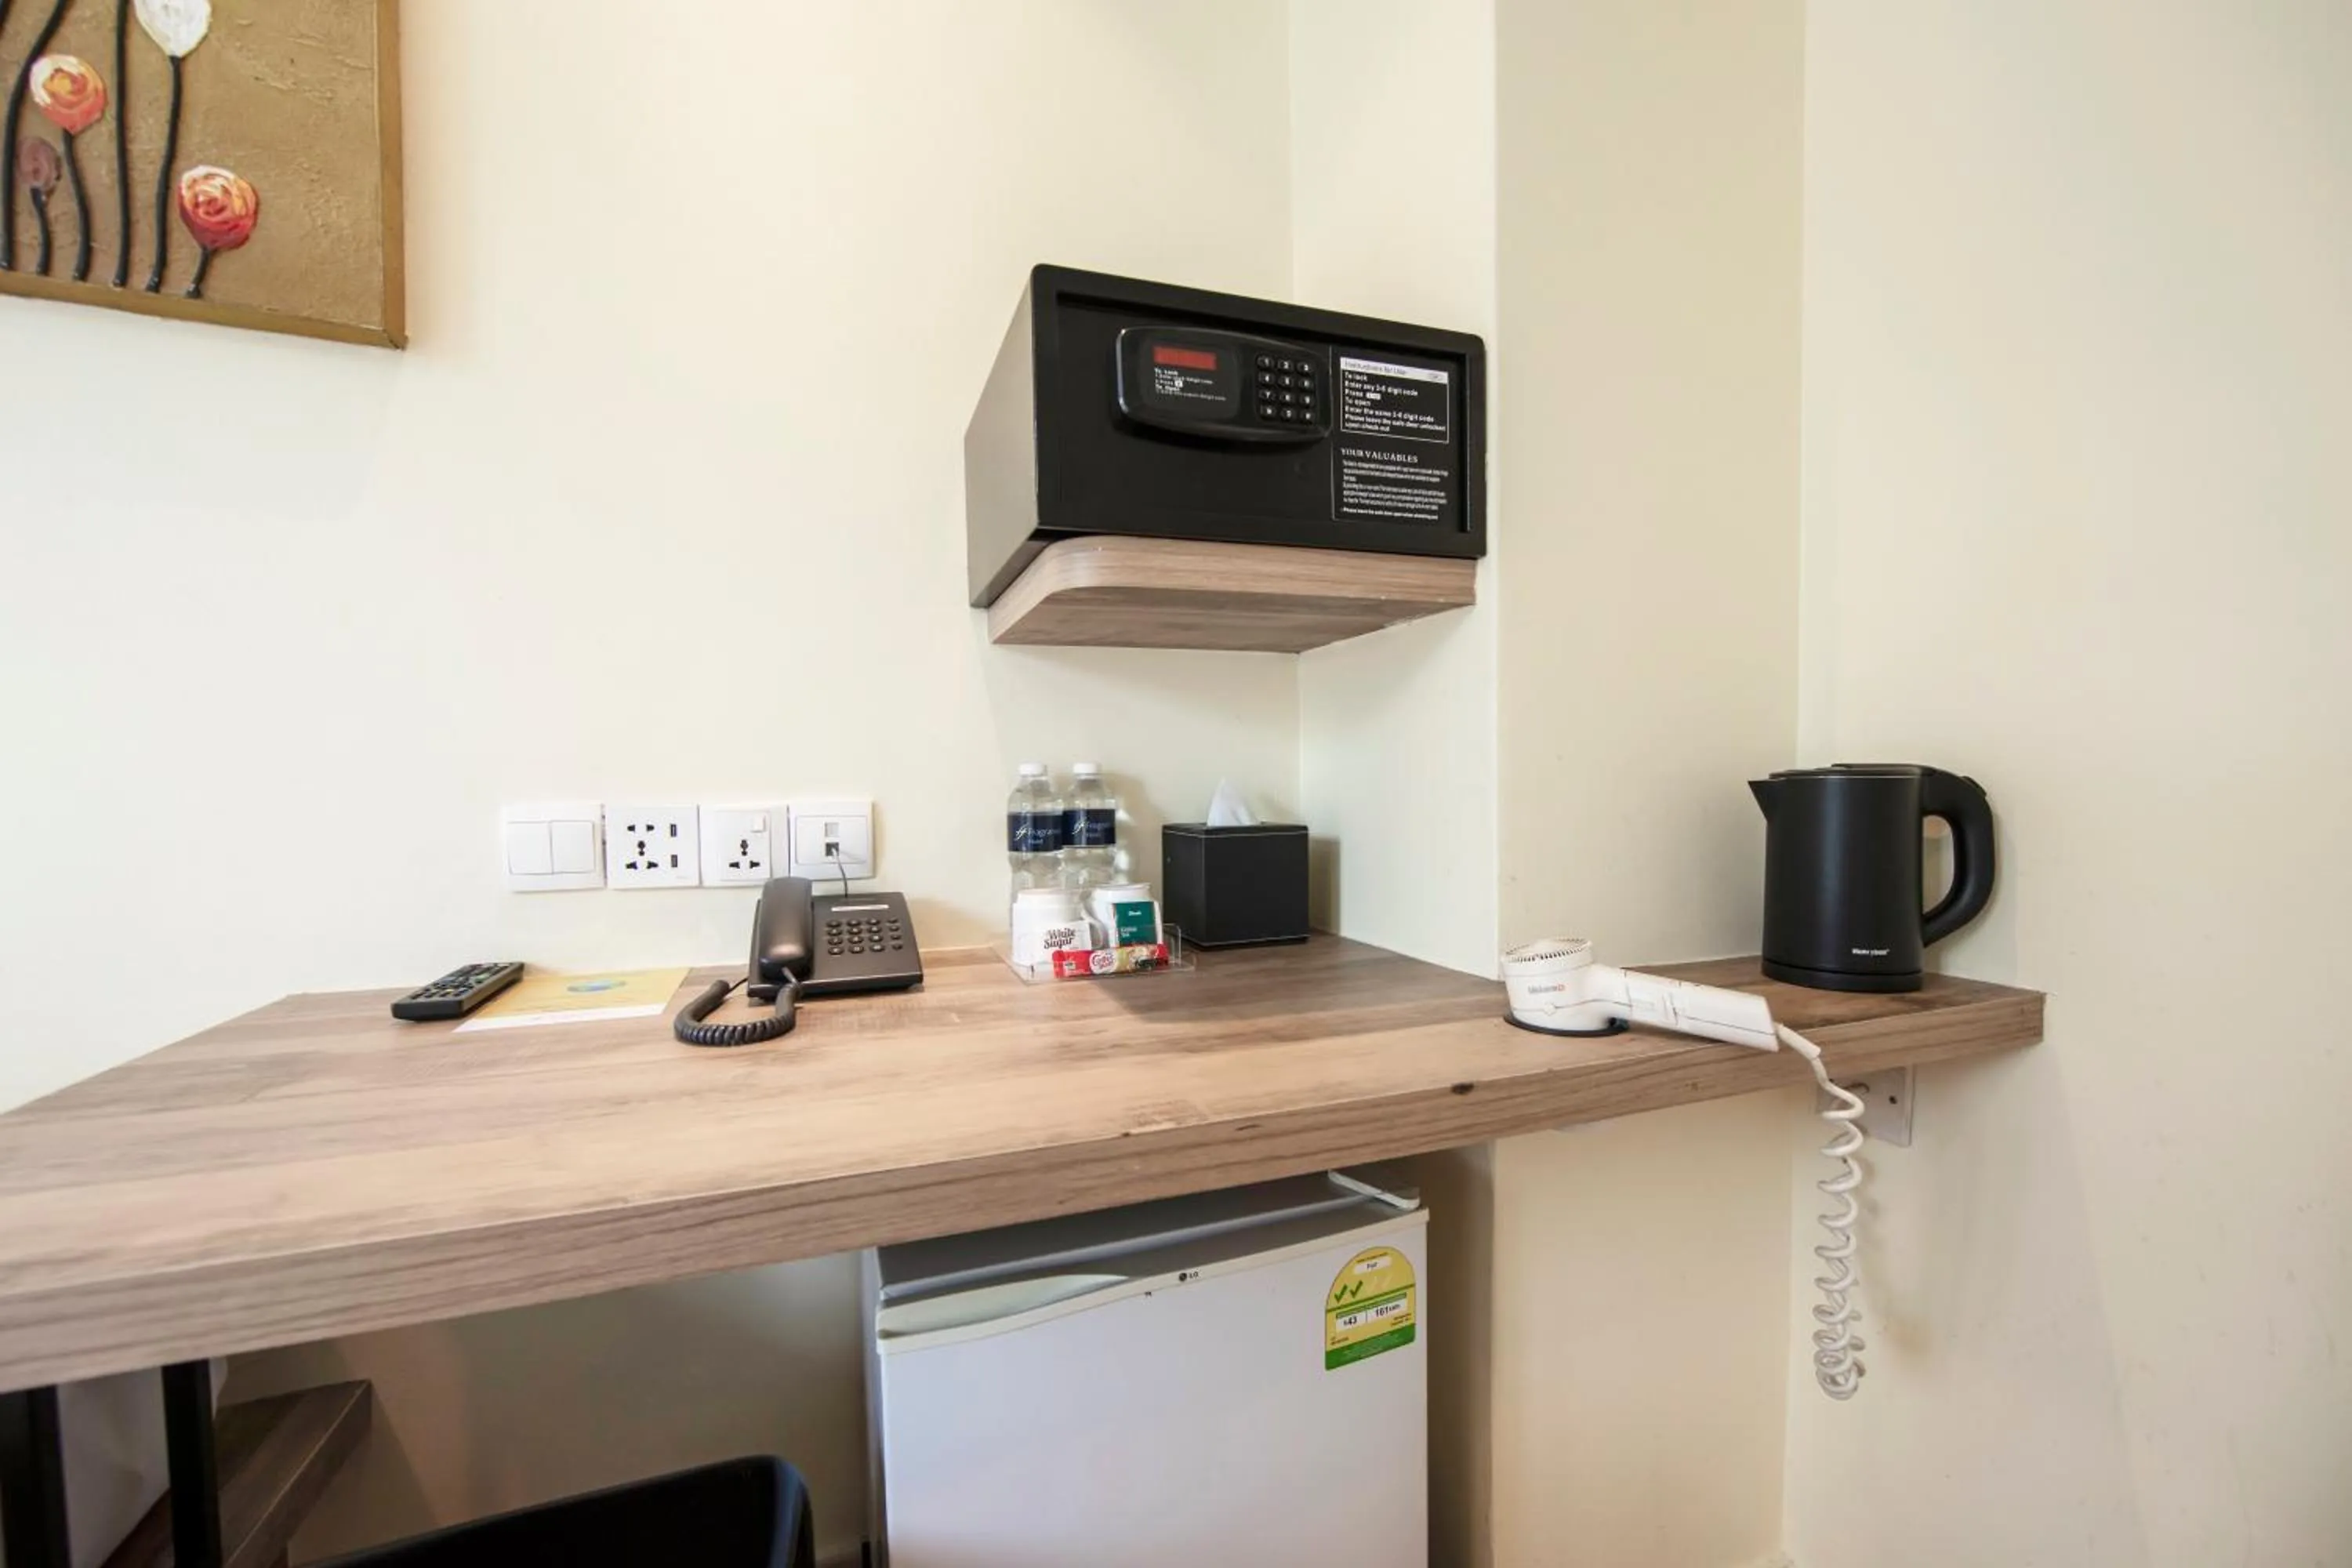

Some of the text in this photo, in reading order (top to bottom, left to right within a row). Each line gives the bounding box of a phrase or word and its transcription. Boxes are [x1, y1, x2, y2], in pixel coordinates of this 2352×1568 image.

[1345, 380, 1362, 390] Enter
[1363, 383, 1375, 393] any
[1345, 396, 1353, 405] To
[1365, 451, 1418, 463] VALUABLES
[1048, 927, 1076, 940] White
[1044, 937, 1075, 949] Sugar
